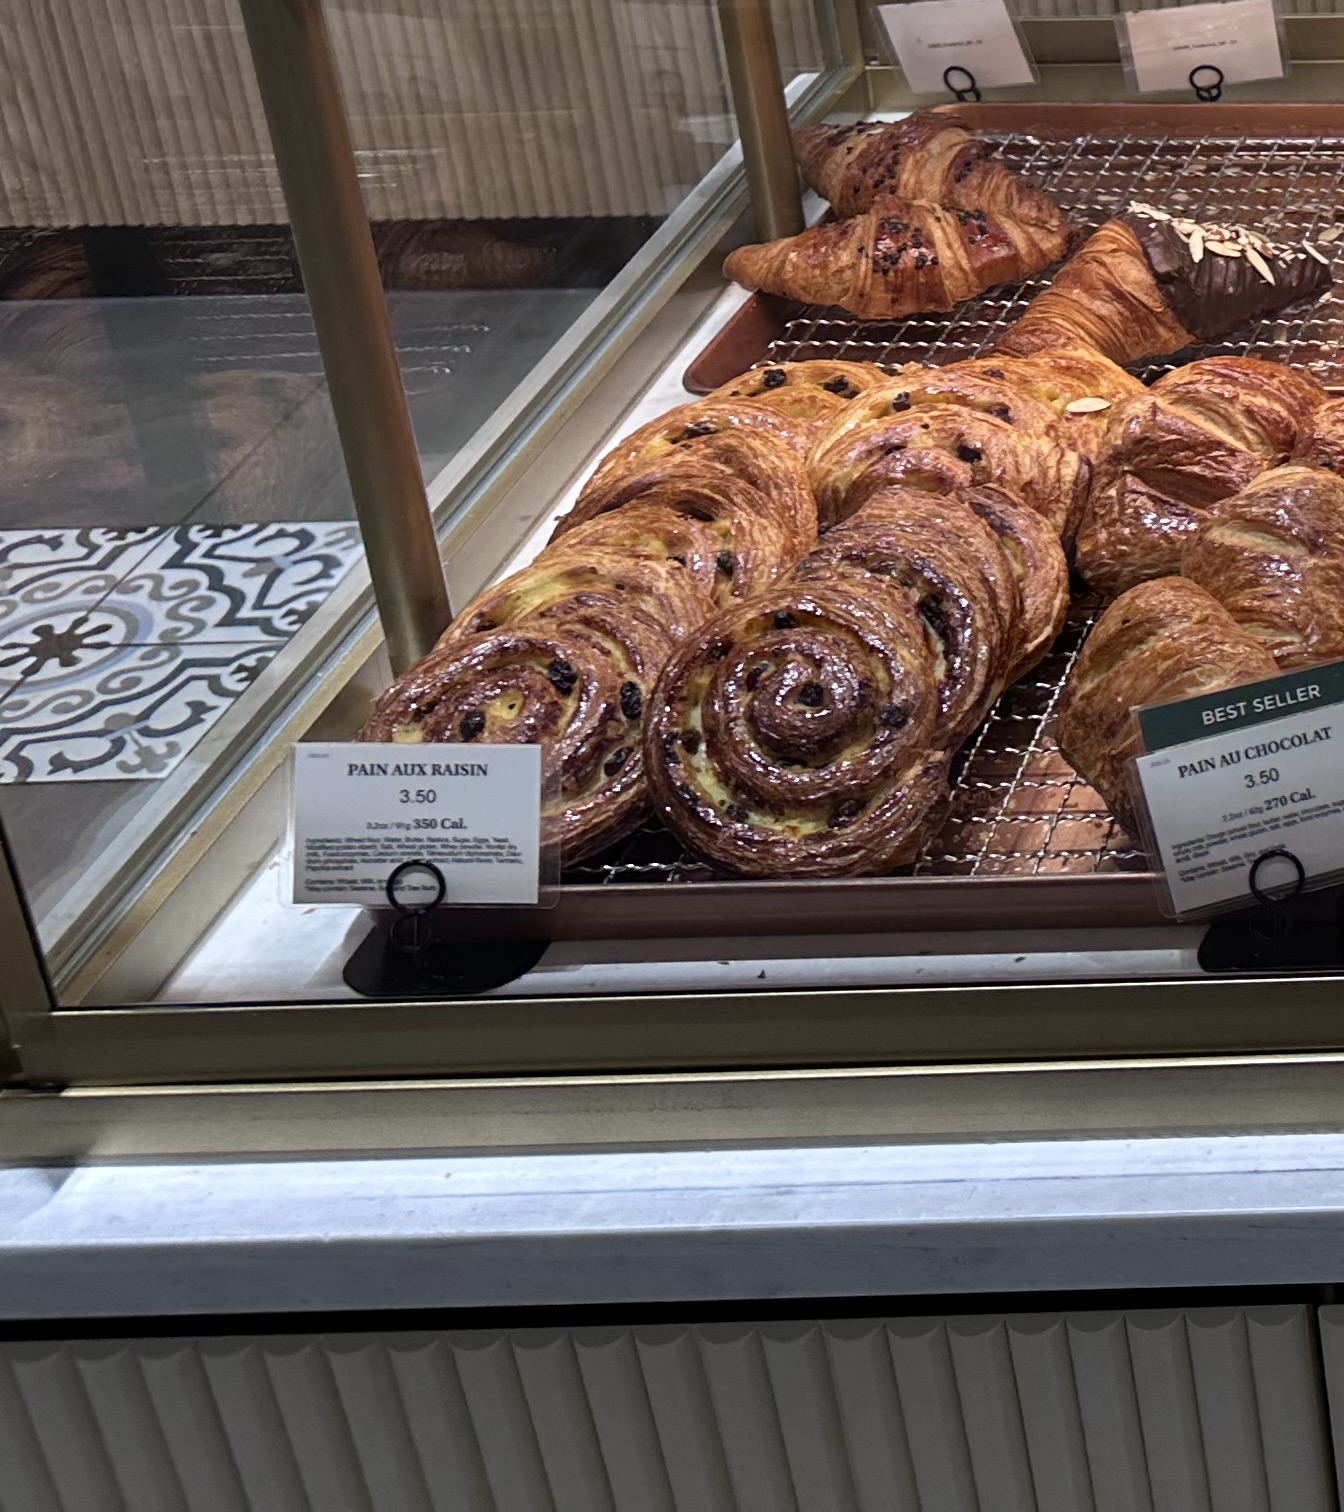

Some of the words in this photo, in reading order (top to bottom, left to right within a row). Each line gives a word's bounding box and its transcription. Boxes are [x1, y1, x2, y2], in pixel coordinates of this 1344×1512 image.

[1201, 701, 1247, 725] BEST
[1253, 684, 1322, 713] SELLER
[1177, 757, 1217, 779] PAIN
[1219, 751, 1242, 768] AU
[1244, 726, 1332, 761] CHOCOLAT
[347, 763, 389, 777] PAIN
[391, 763, 428, 776] AUX
[431, 763, 489, 777] RAISIN
[1243, 768, 1280, 788] 3.50
[399, 789, 437, 804] 3.50
[1264, 796, 1288, 812] 270
[1290, 788, 1317, 804] Cal.
[413, 818, 438, 830] 350
[440, 818, 468, 830] Cal.
